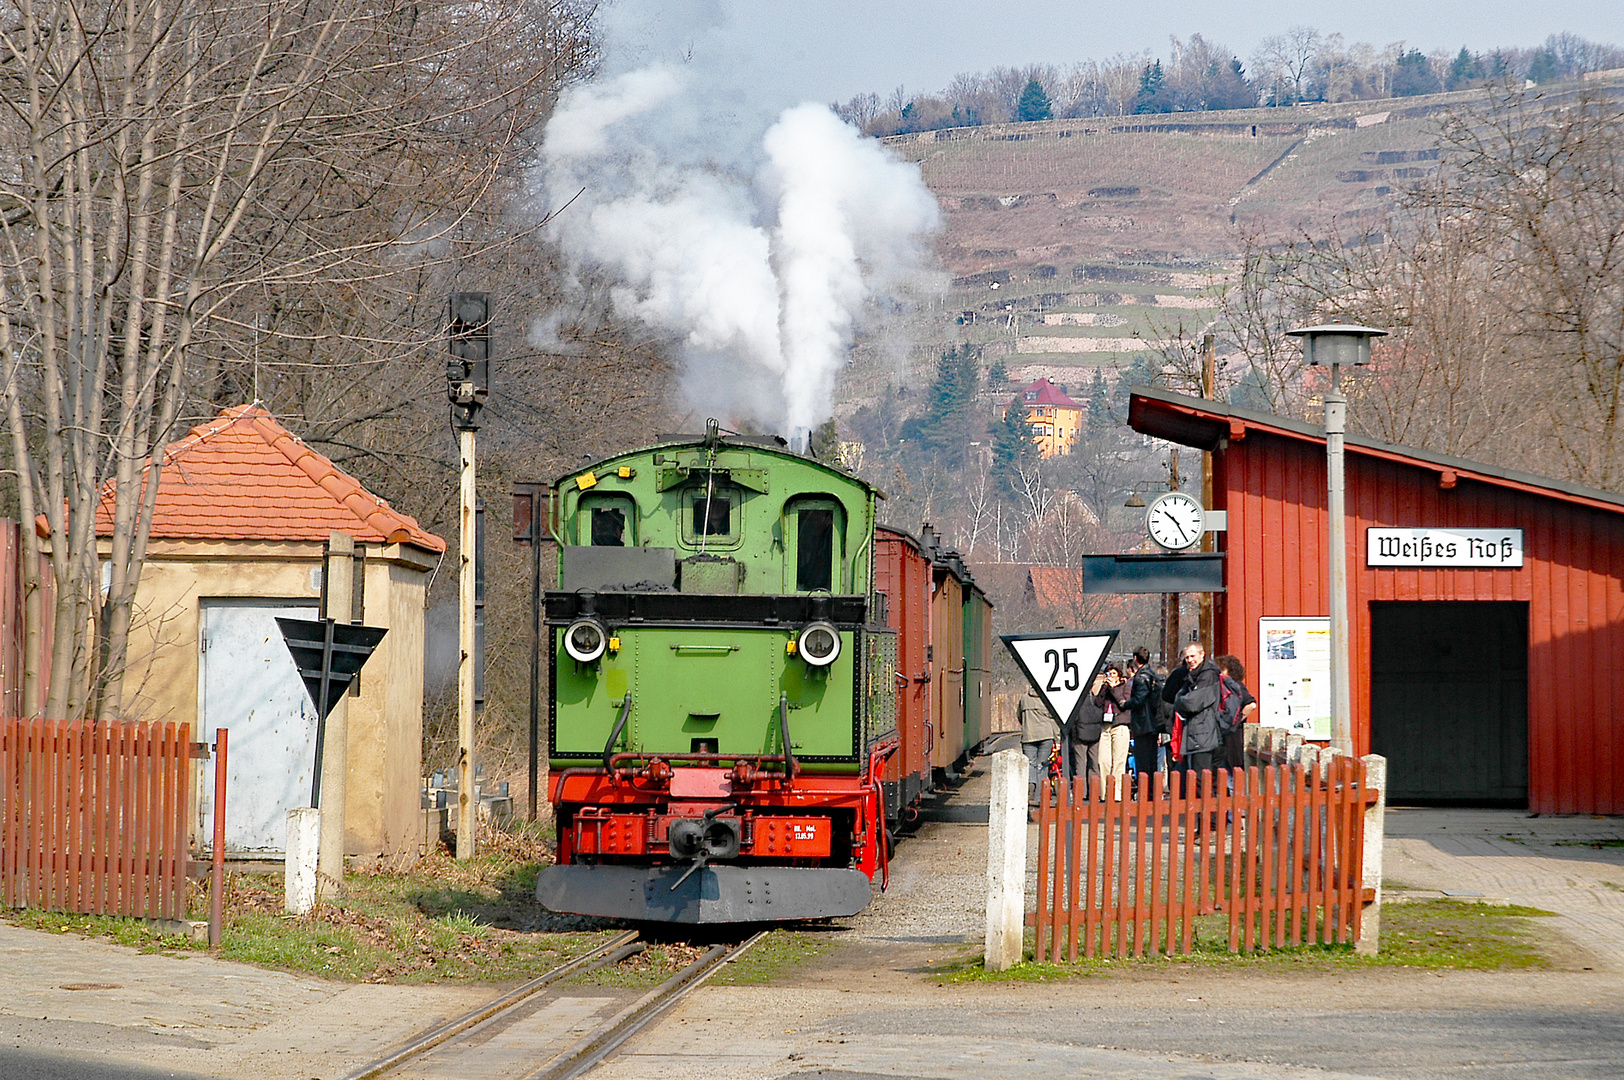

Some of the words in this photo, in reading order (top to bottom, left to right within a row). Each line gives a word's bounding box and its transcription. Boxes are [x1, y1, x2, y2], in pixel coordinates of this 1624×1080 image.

[1378, 537, 1456, 562] Weißes
[1467, 537, 1513, 562] Roß
[1044, 648, 1079, 692] 25
